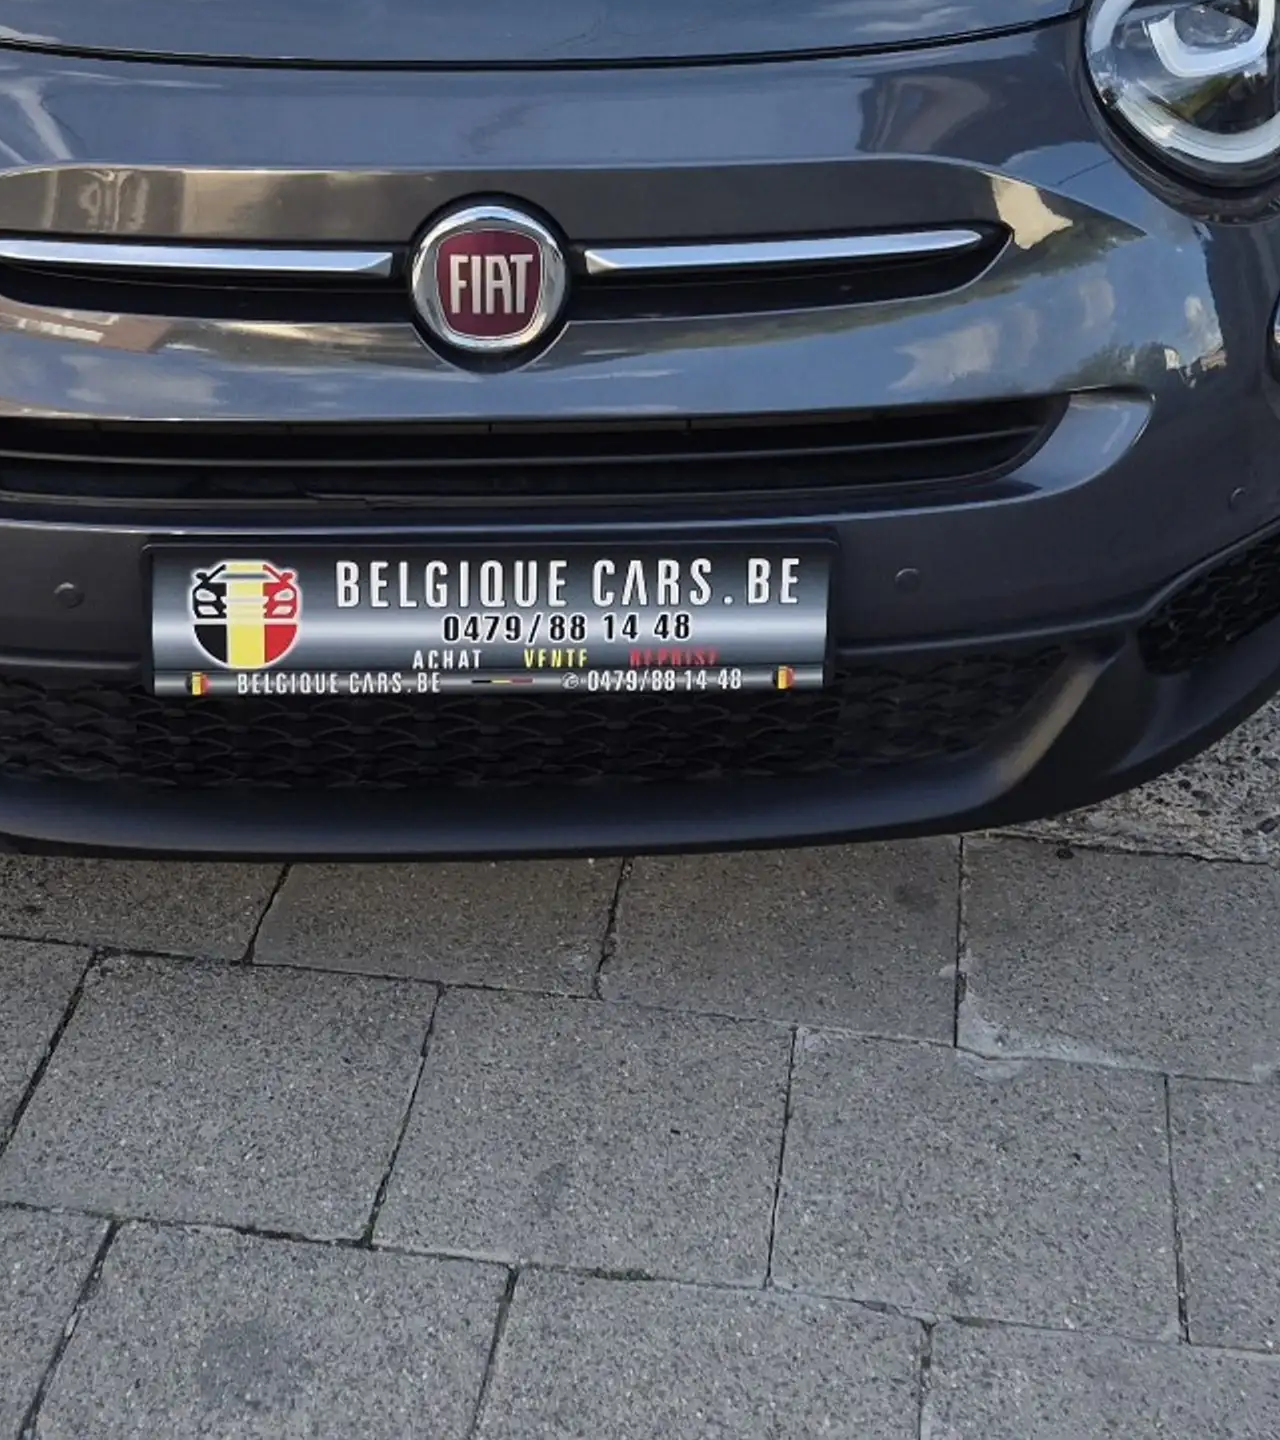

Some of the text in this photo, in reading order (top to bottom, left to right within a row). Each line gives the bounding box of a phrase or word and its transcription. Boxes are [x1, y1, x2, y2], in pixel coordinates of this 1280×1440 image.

[449, 253, 534, 315] FIAT
[335, 559, 568, 608] BELGIQUE
[442, 611, 691, 644] 0479/88 14 48
[412, 649, 482, 670] ACHAT
[237, 672, 339, 695] BELGIQUE
[587, 668, 742, 692] 0479/88 14 48
